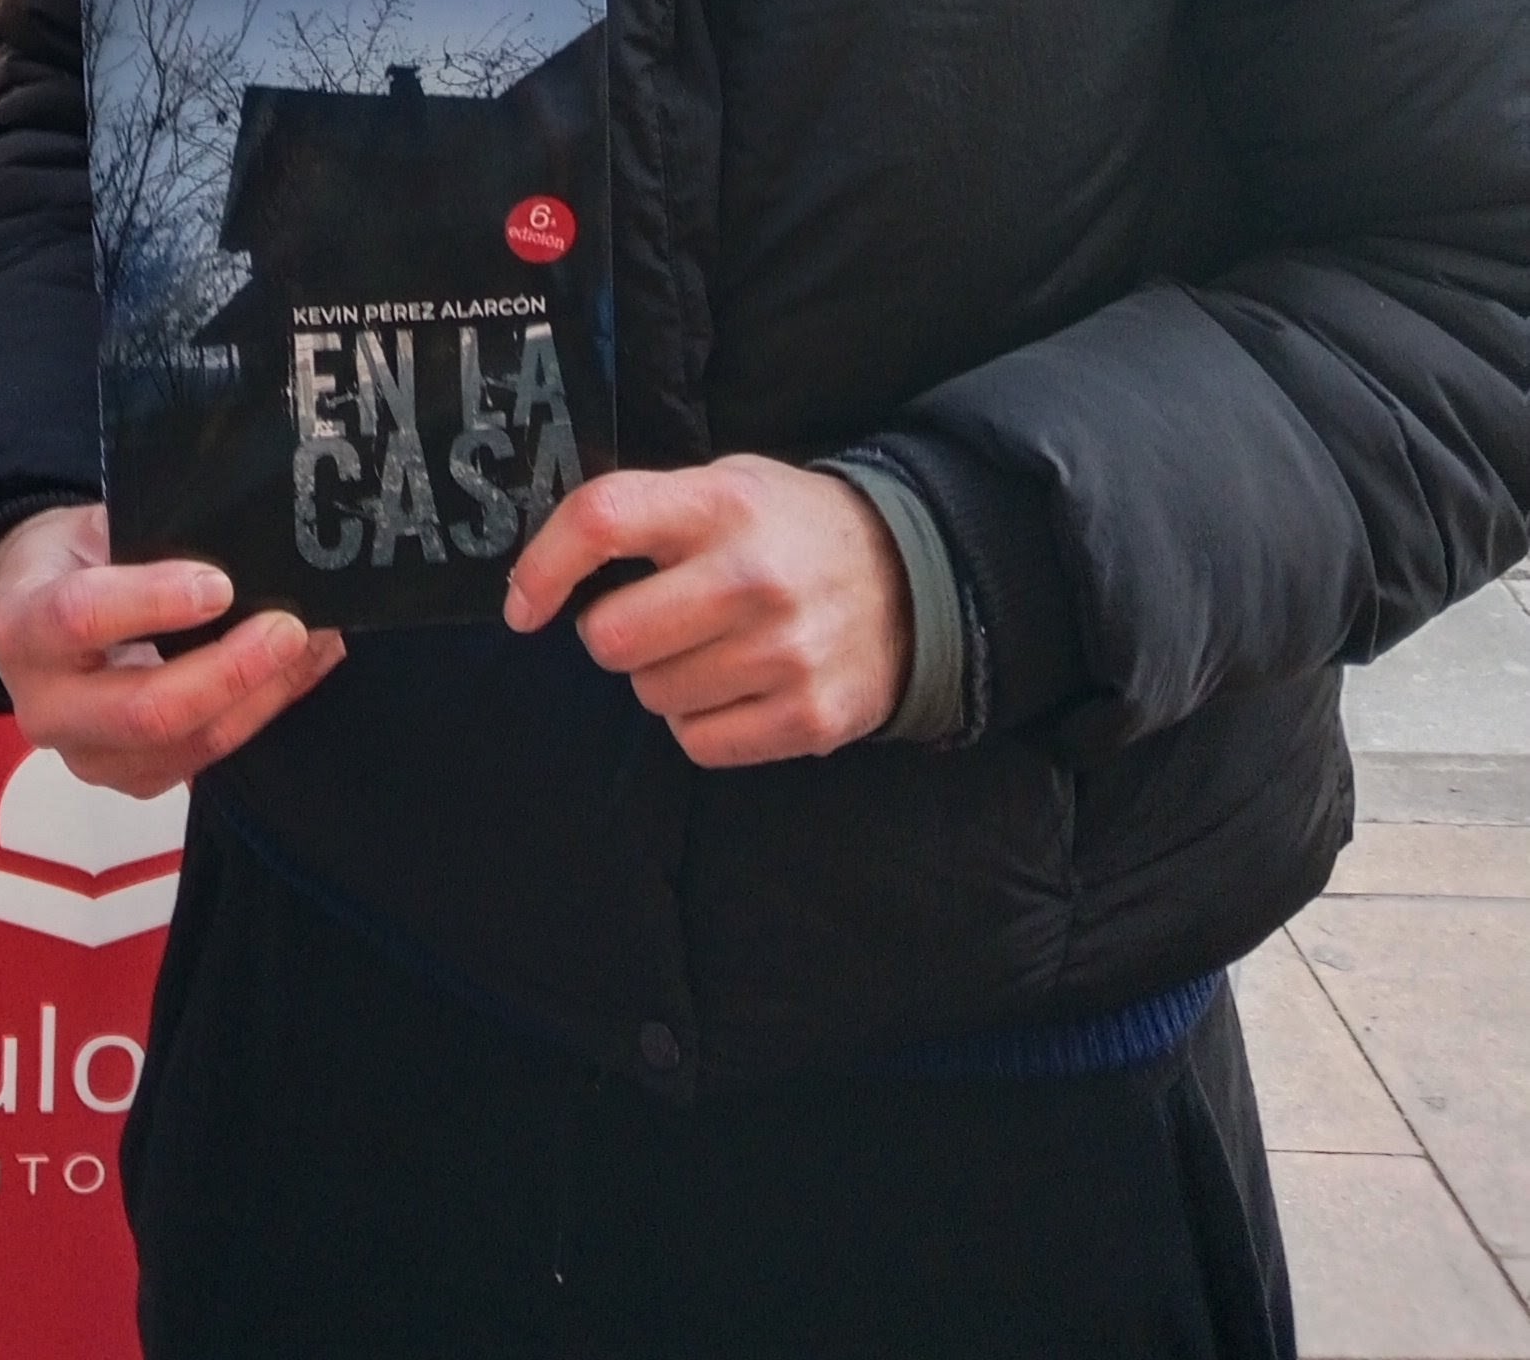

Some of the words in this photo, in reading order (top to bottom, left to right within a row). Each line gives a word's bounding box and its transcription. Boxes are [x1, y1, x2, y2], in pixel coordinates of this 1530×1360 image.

[293, 305, 358, 326] KEVIN
[364, 300, 435, 324] PÉREZ
[440, 294, 547, 319] ALARCÓN
[292, 328, 417, 440] EN
[458, 321, 572, 431] LA
